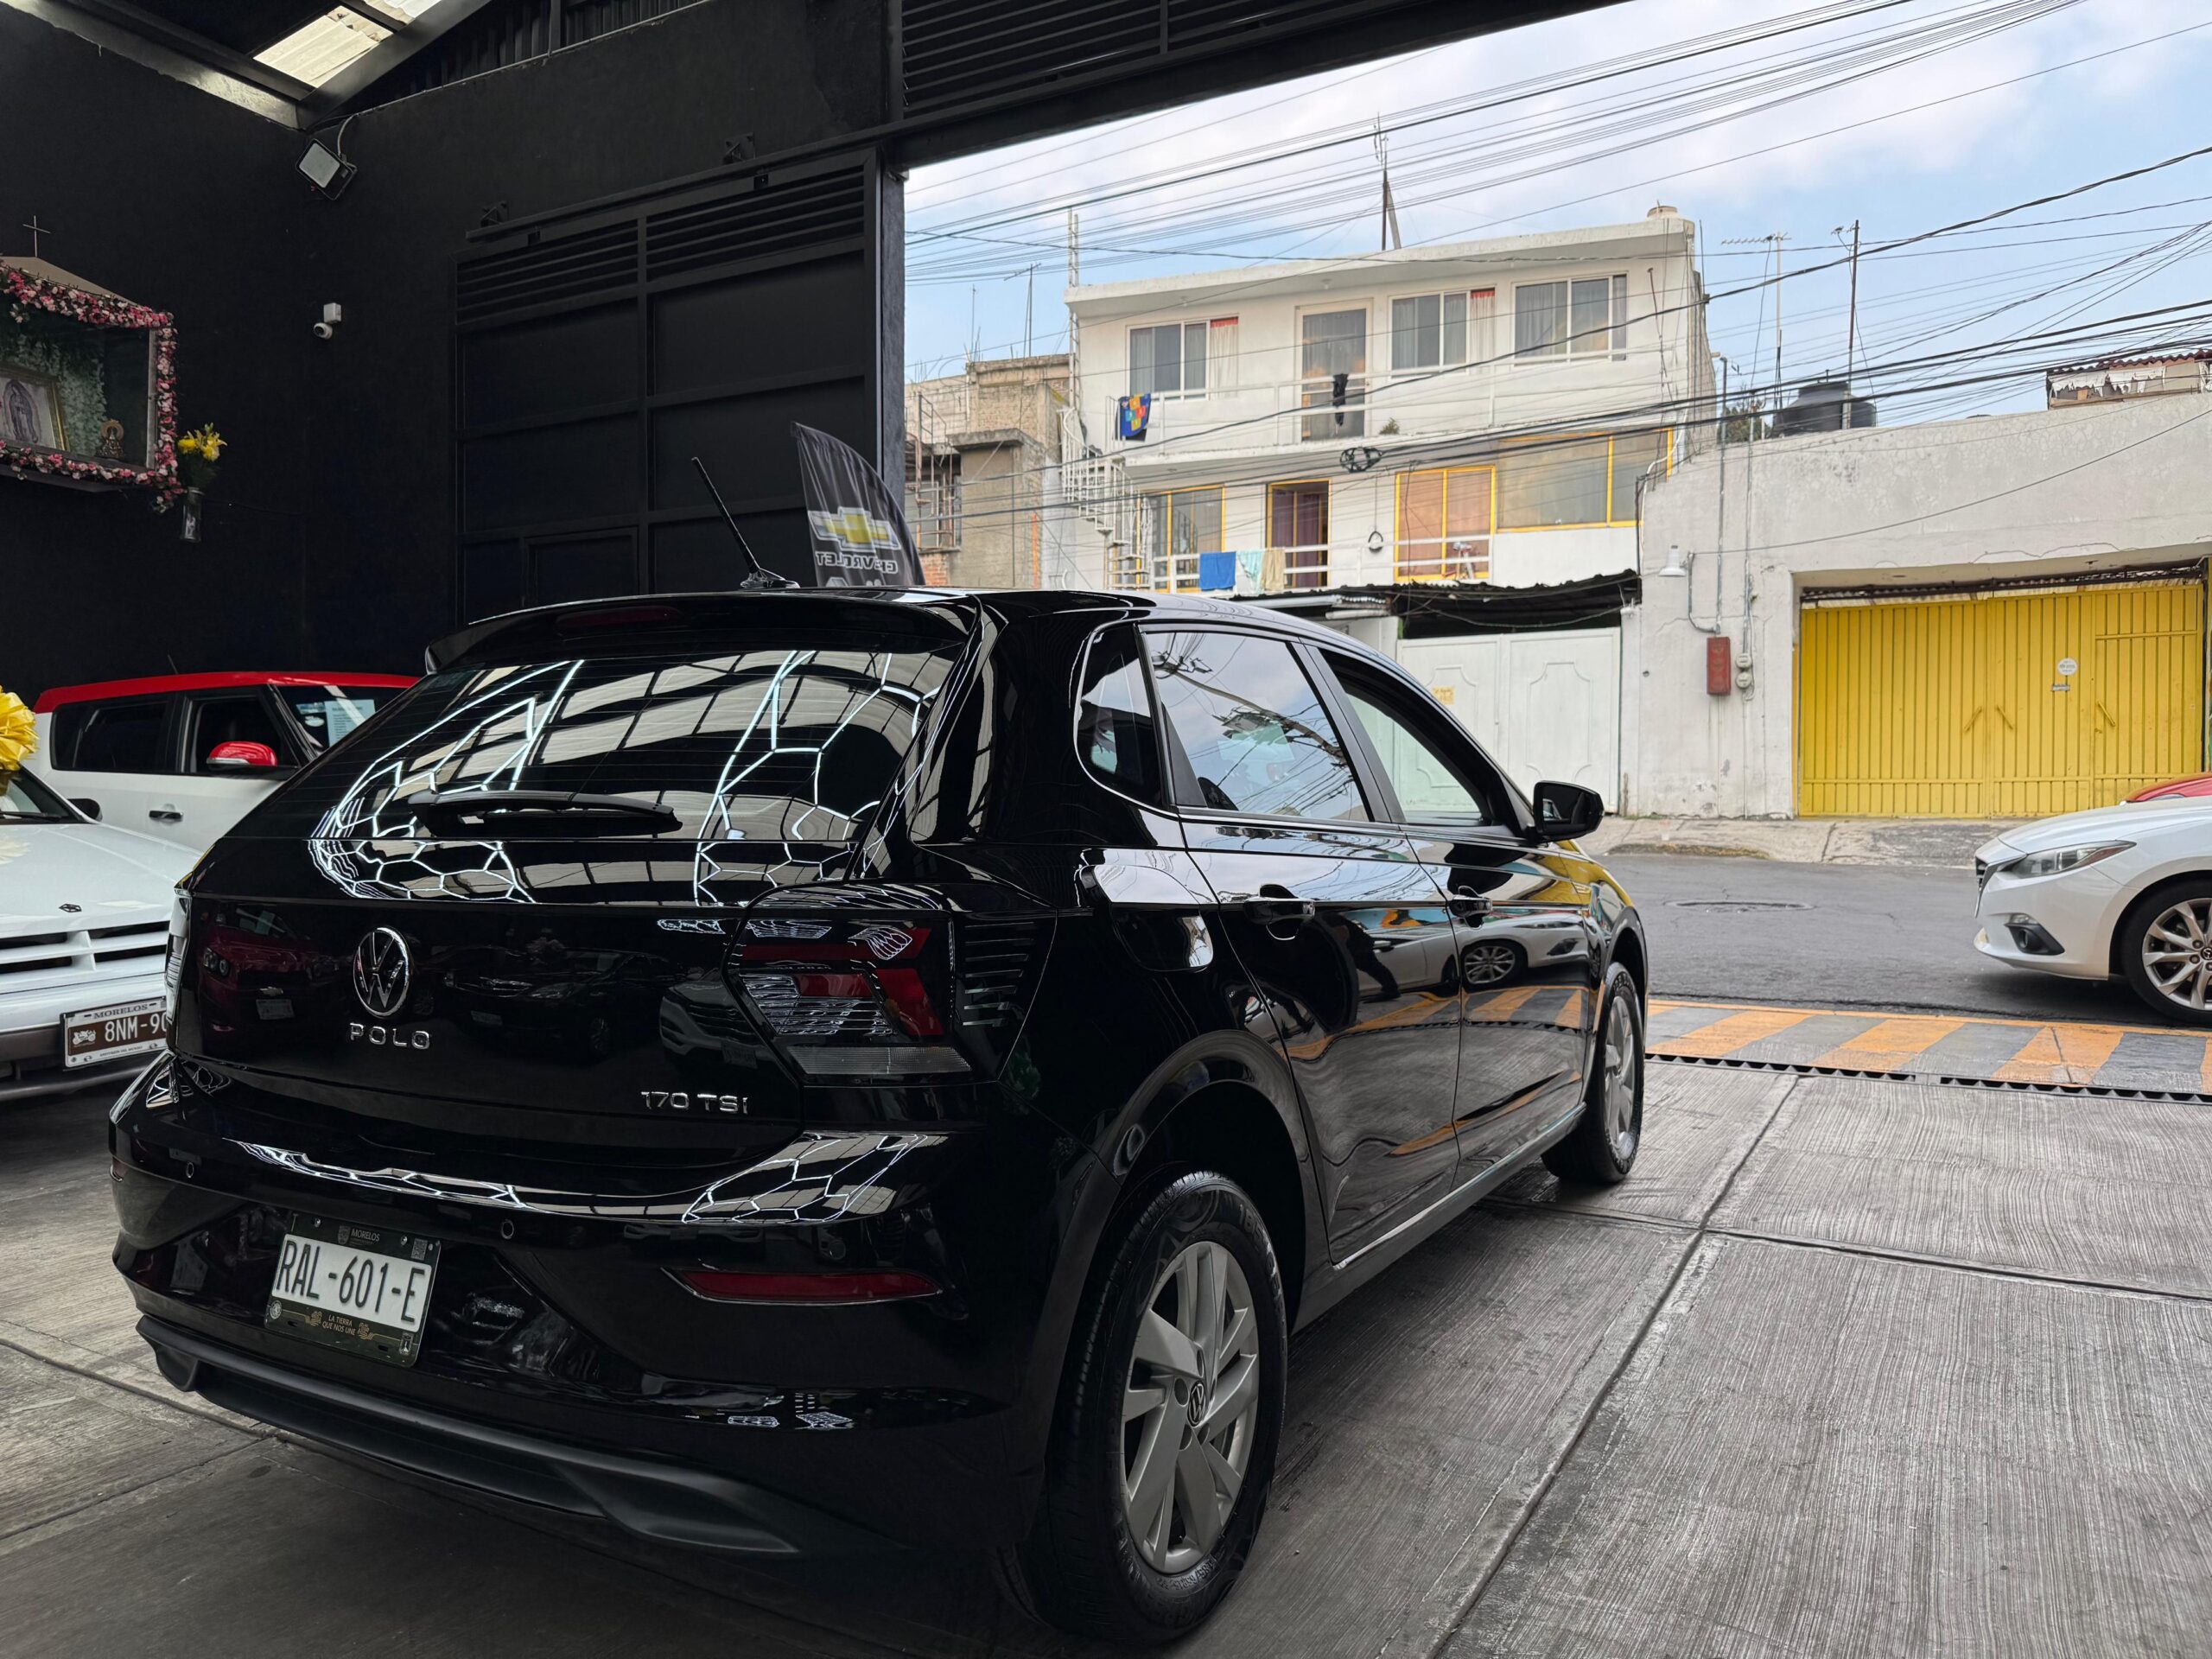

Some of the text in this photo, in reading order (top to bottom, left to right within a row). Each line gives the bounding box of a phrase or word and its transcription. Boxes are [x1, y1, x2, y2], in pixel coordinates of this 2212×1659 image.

[93, 1003, 149, 1020] MORELOS
[349, 1022, 430, 1050] POLO
[640, 1091, 690, 1110] 170
[351, 1228, 380, 1243] MORELOS
[276, 1240, 425, 1324] RAL-601-E
[322, 1321, 356, 1336] QUE NOS UNE
[336, 1316, 353, 1327] TIERRA
